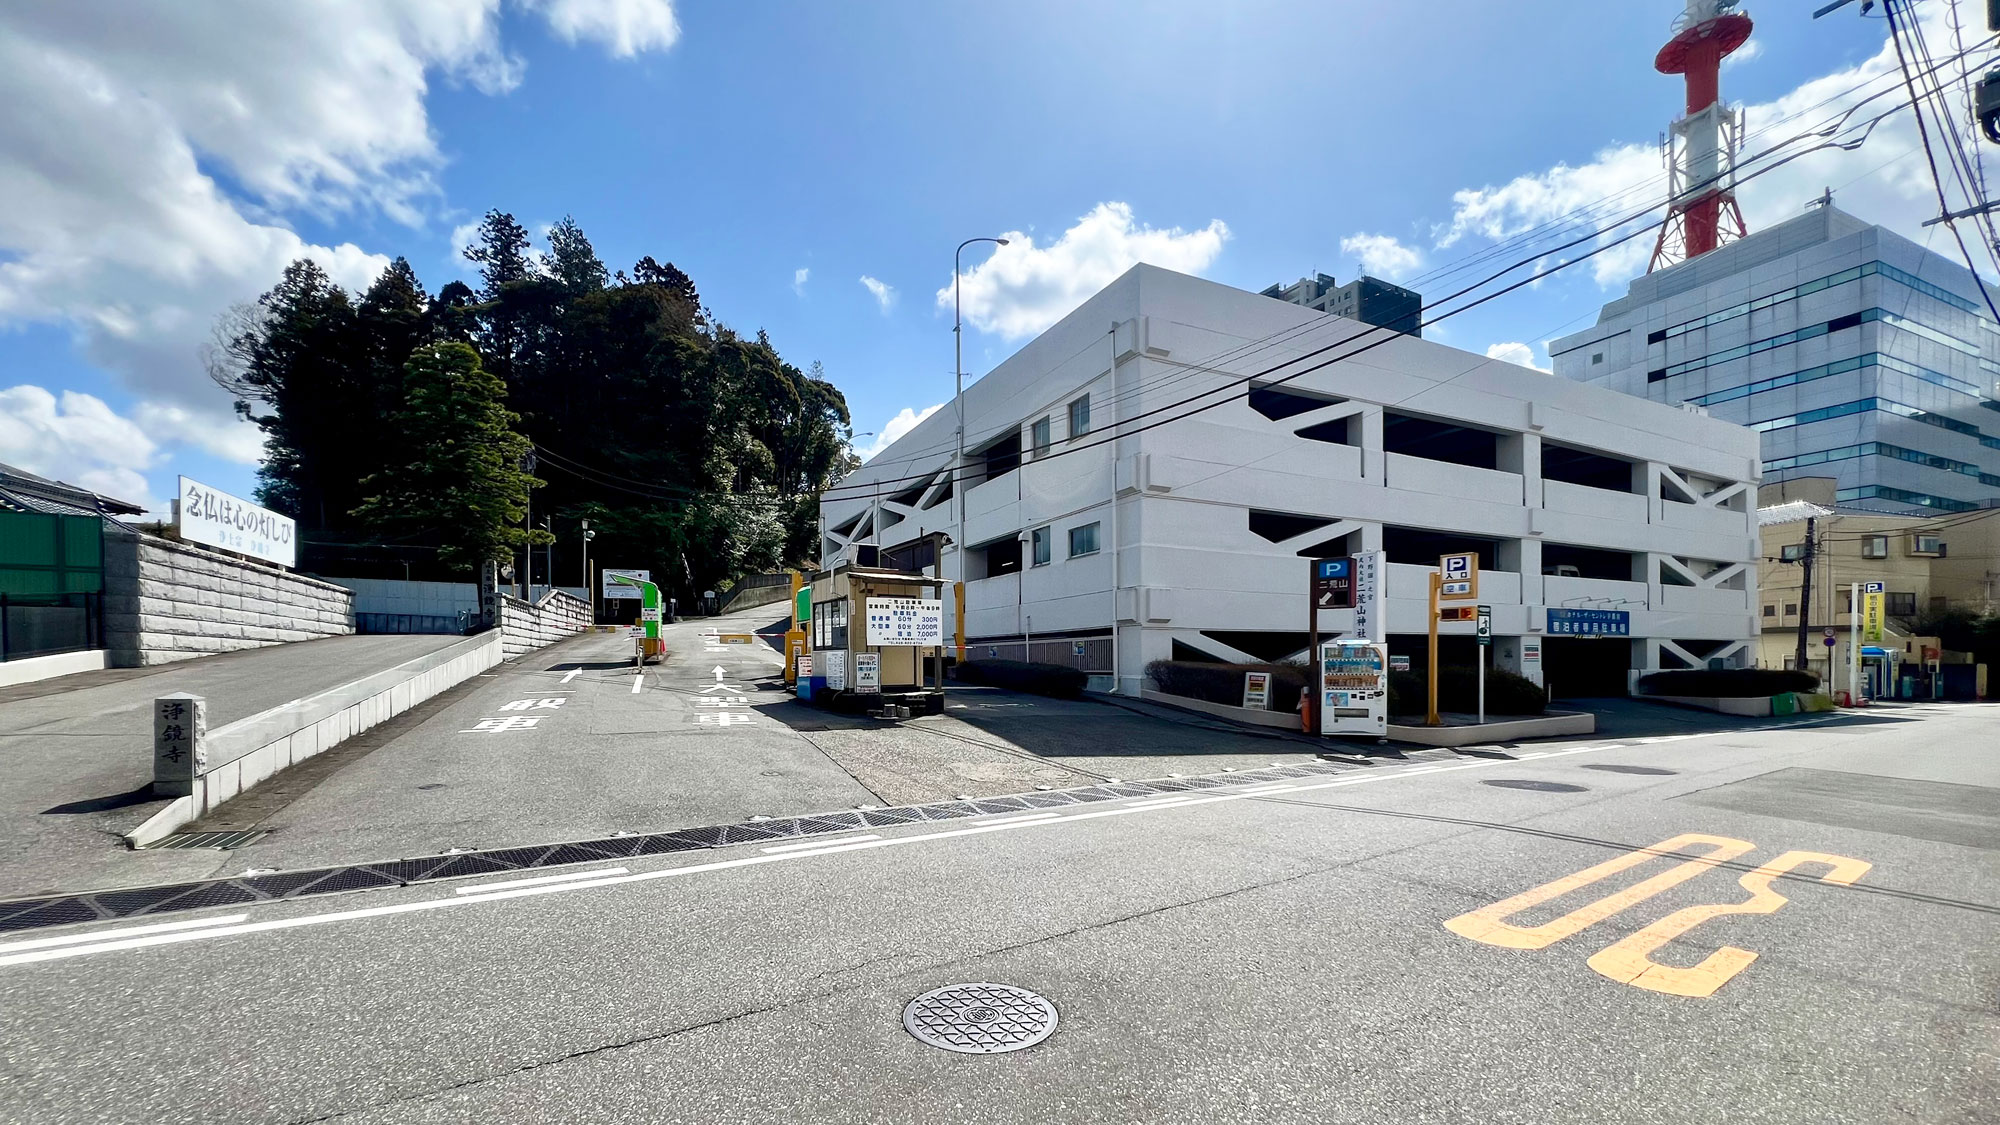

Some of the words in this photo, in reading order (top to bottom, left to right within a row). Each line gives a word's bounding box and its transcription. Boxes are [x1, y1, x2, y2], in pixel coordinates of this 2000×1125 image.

[186, 485, 292, 544] 念仏は心の灯しび
[1326, 563, 1341, 576] P
[1449, 558, 1464, 571] P
[1446, 571, 1468, 579] 入口
[1319, 579, 1349, 589] 二荒山
[1446, 584, 1467, 593] 空車
[1867, 583, 1879, 593] P
[1356, 583, 1367, 639] 二荒山神社
[161, 702, 187, 763] 浄鏡寺
